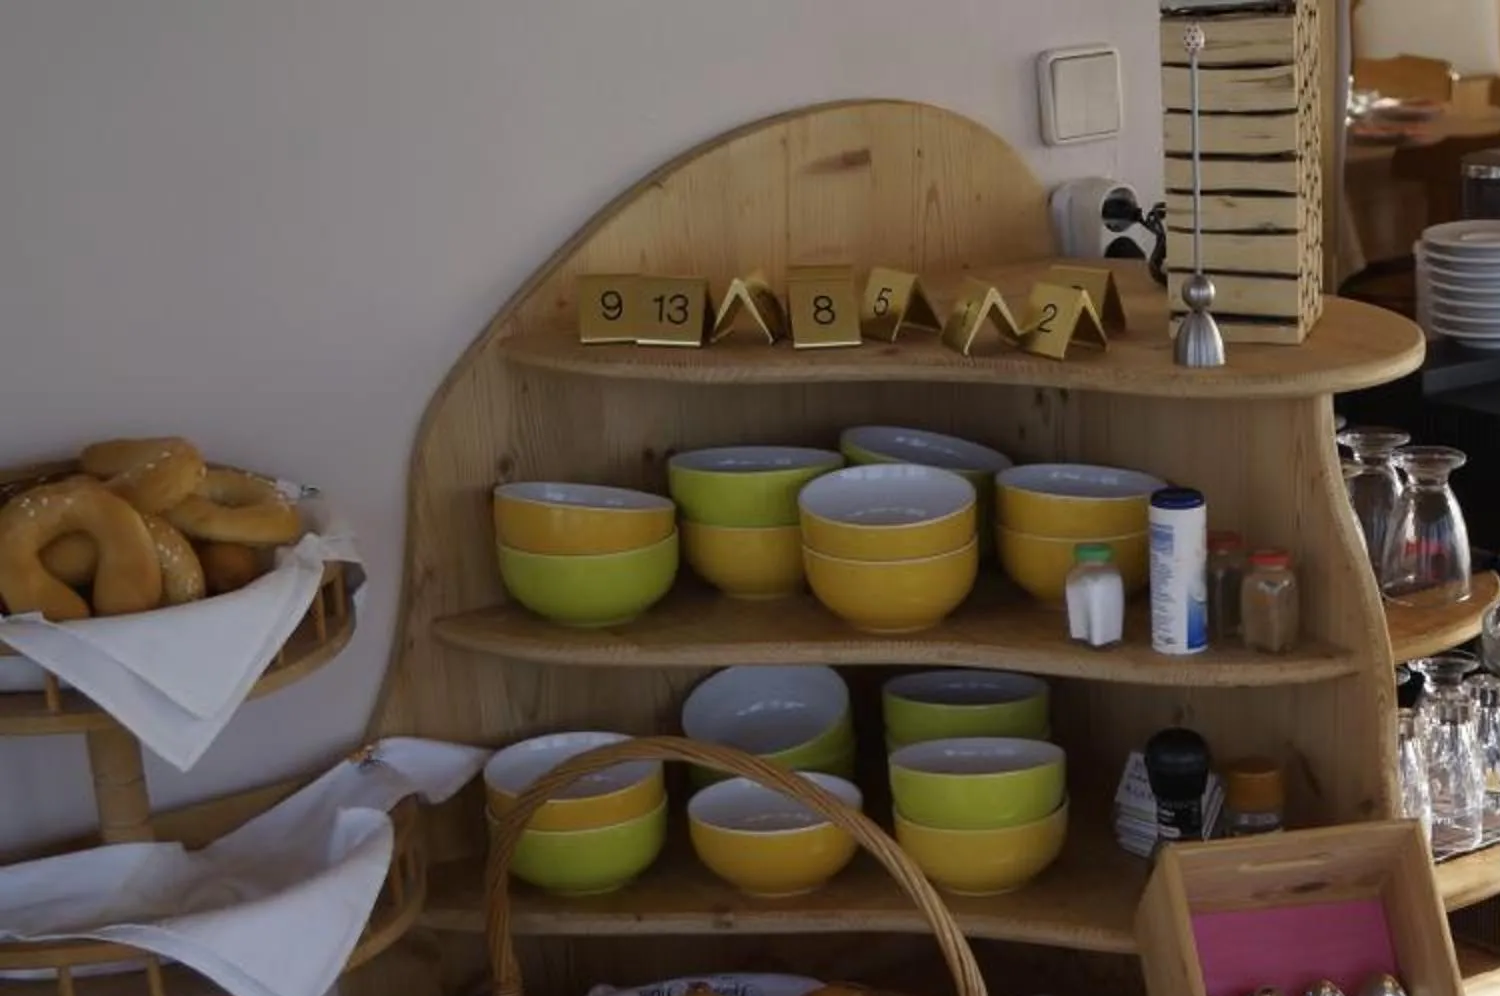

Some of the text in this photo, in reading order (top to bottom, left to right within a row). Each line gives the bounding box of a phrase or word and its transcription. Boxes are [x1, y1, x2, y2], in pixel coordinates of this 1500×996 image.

[600, 290, 624, 321] 9
[652, 294, 690, 325] 13
[812, 295, 836, 325] 8
[872, 286, 892, 317] 5
[1037, 303, 1058, 333] 2
